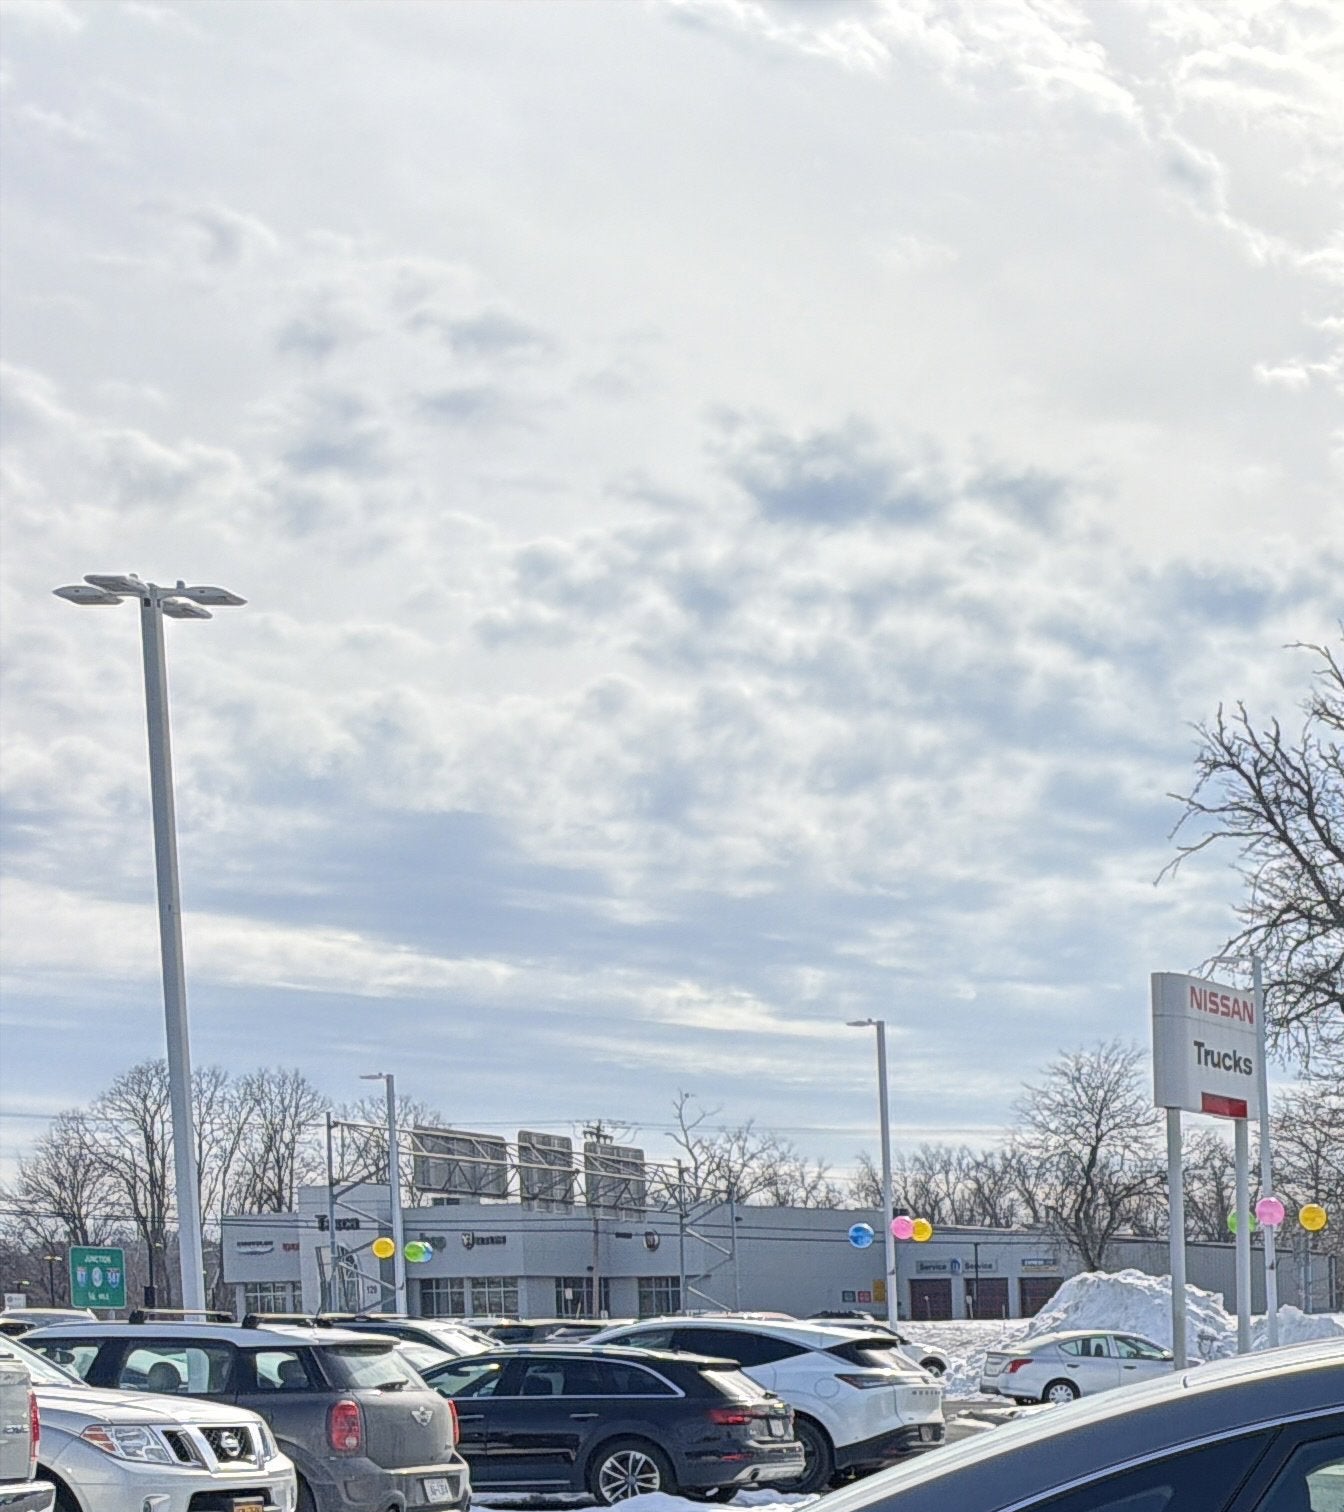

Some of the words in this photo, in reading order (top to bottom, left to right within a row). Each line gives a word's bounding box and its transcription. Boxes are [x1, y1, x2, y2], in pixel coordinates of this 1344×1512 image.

[1190, 986, 1254, 1024] NISSAN
[1193, 1040, 1253, 1076] Trucks
[965, 1262, 992, 1270] Sevice
